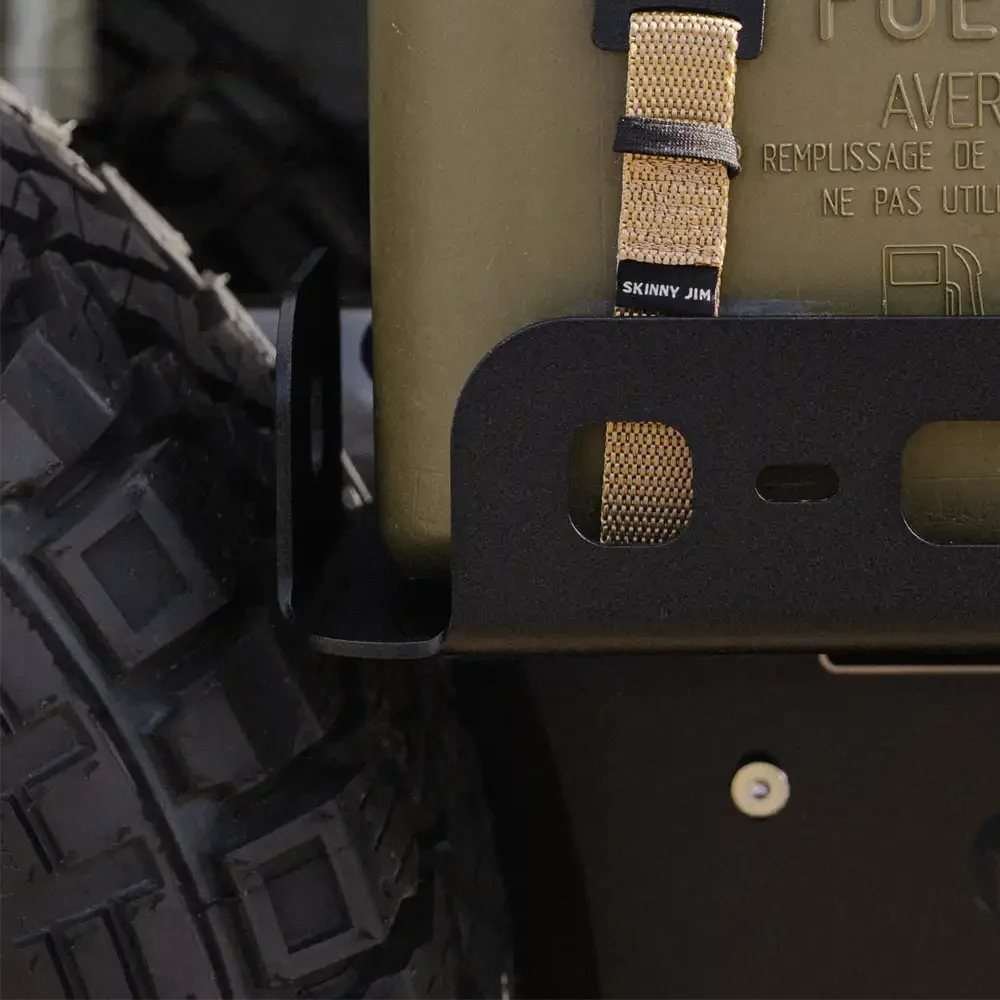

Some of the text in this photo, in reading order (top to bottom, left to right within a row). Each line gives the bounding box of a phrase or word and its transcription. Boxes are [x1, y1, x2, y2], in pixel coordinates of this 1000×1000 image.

[762, 141, 934, 172] REMPLISSAGE
[953, 140, 986, 170] DE
[821, 187, 855, 217] NE
[874, 184, 923, 216] PAS
[622, 281, 711, 302] SKINNY JIM
